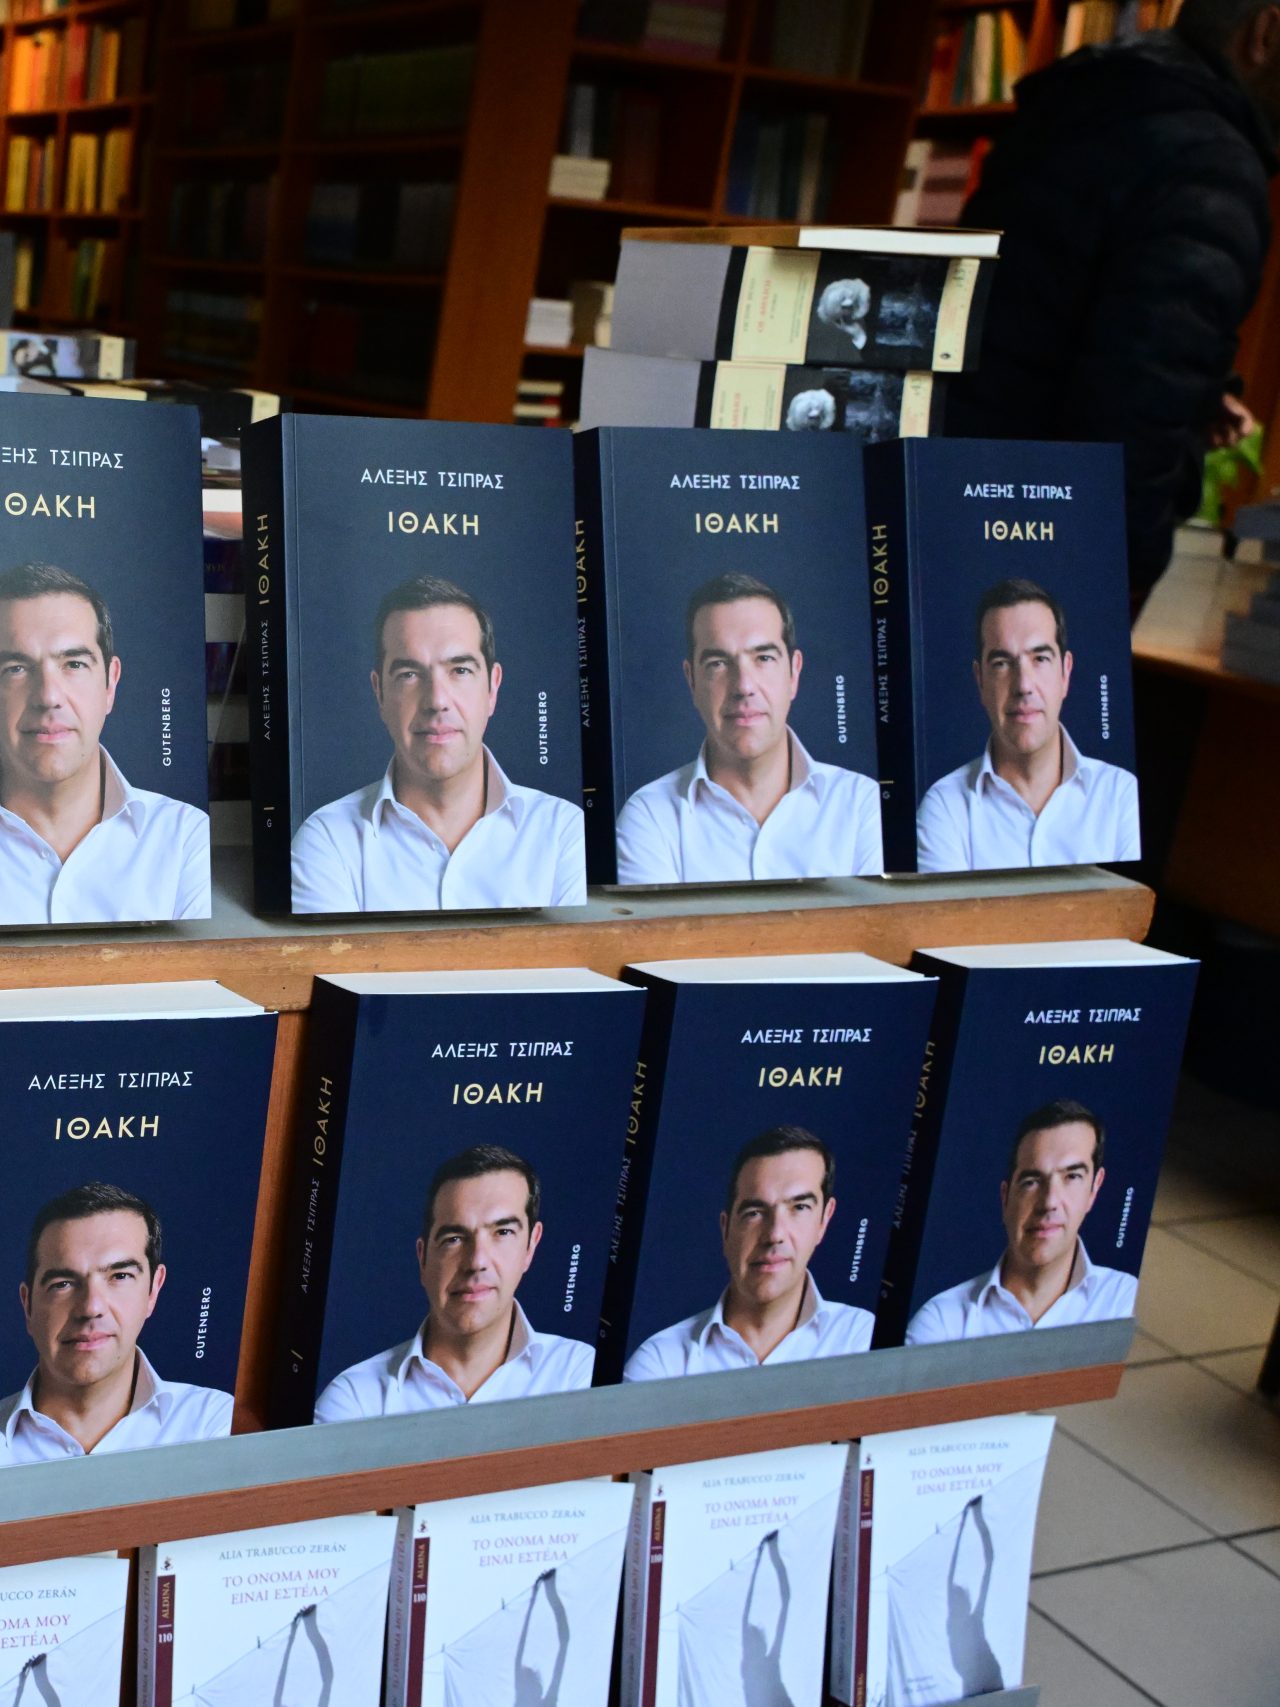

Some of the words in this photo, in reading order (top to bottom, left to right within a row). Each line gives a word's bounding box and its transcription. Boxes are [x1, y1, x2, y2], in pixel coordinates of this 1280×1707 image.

[50, 450, 123, 468] ΤΣΙΠΡΑΣ
[361, 468, 427, 485] ΑΛΕΞΗΣ
[438, 472, 503, 489] ΤΣΙΠΡΑΣ
[670, 474, 730, 489] ΑΛΕΞΗΣ
[740, 475, 800, 489] ΤΣΙΠΡΑΣ
[964, 484, 1014, 498] ΑΛΕΞΗΣ
[1022, 485, 1072, 499] ΤΣΙΠΡΑΣ
[389, 512, 478, 535] ΙΘΑΚΗ
[696, 513, 778, 533] ΙΘΑΚΗ
[985, 521, 1053, 540] ΙΘΑΚΗ
[257, 513, 271, 606] ΙΘΑΚΗ
[574, 519, 588, 603] ΙΘΑΚΗ
[871, 524, 889, 605] ΙΘΑΚΗ
[262, 619, 270, 678] ΤΣΙΠΡΑΣ
[577, 615, 588, 668] ΤΣΙΠΡΑΣ
[876, 616, 887, 668] ΤΣΙΠΡΑΣ
[580, 677, 591, 728] ΑΛΕΞΗΣ
[836, 675, 847, 743] GUTENBERG
[878, 674, 889, 724] ΑΛΕΞΗΣ
[1101, 674, 1110, 740] GUTENBERG
[263, 684, 272, 741] ΑΛΕΞΗΣ
[162, 688, 171, 766] GUTENBERG
[539, 692, 548, 764] GUTENBERG
[1024, 1010, 1080, 1023] ΑΛΕΞΗΣ
[1089, 1008, 1141, 1022] ΤΣΙΠΡΑΣ
[741, 1029, 803, 1043] ΑΛΕΞΗΣ
[813, 1029, 871, 1043] ΤΣΙΠΡΑΣ
[432, 1043, 498, 1057] ΑΛΕΞΗΣ
[510, 1042, 573, 1056] ΤΣΙΠΡΑΣ
[1039, 1044, 1114, 1064] ΙΘΑΚΗ
[28, 1074, 105, 1090] ΑΛΕΞΗΣ
[119, 1072, 193, 1088] ΤΣΙΠΡΑΣ
[759, 1067, 842, 1087] ΙΘΑΚΗ
[453, 1083, 542, 1104] ΙΘΑΚΗ
[625, 1061, 648, 1145] ΙΘΑΚΗ
[56, 1116, 158, 1139] ΙΘΑΚΗ
[312, 1076, 333, 1167] ΙΘΑΚΗ
[306, 1177, 321, 1232] ΤΣΙΠΡΑΣ
[1116, 1187, 1134, 1248] GUTENBERG
[850, 1218, 868, 1282] GUTENBERG
[300, 1239, 314, 1295] ΑΛΕΞΗΣ
[564, 1244, 580, 1312] GUTENBERG
[196, 1287, 211, 1358] GUTENBERG
[220, 1550, 242, 1560] ALIA
[246, 1545, 306, 1557] TRABUCCO
[310, 1541, 346, 1554] ZERÁN
[473, 1539, 490, 1550] ΤΟ
[494, 1536, 544, 1548] ΟΝΟΜΑ
[549, 1534, 578, 1544] ΜΟΥ
[480, 1553, 513, 1567] ΕΙΝΑΙ
[223, 1576, 243, 1588] ΤΟ
[248, 1571, 302, 1584] ΟΝΟΜΑ
[307, 1567, 340, 1580] ΜΟΥ
[38, 1589, 76, 1599] ZERÁN
[161, 1582, 171, 1620] ALDINA
[232, 1590, 268, 1605] ΕΙΝΑΙ
[35, 1614, 72, 1627] ΜΟΥ
[158, 1633, 173, 1644] 110
